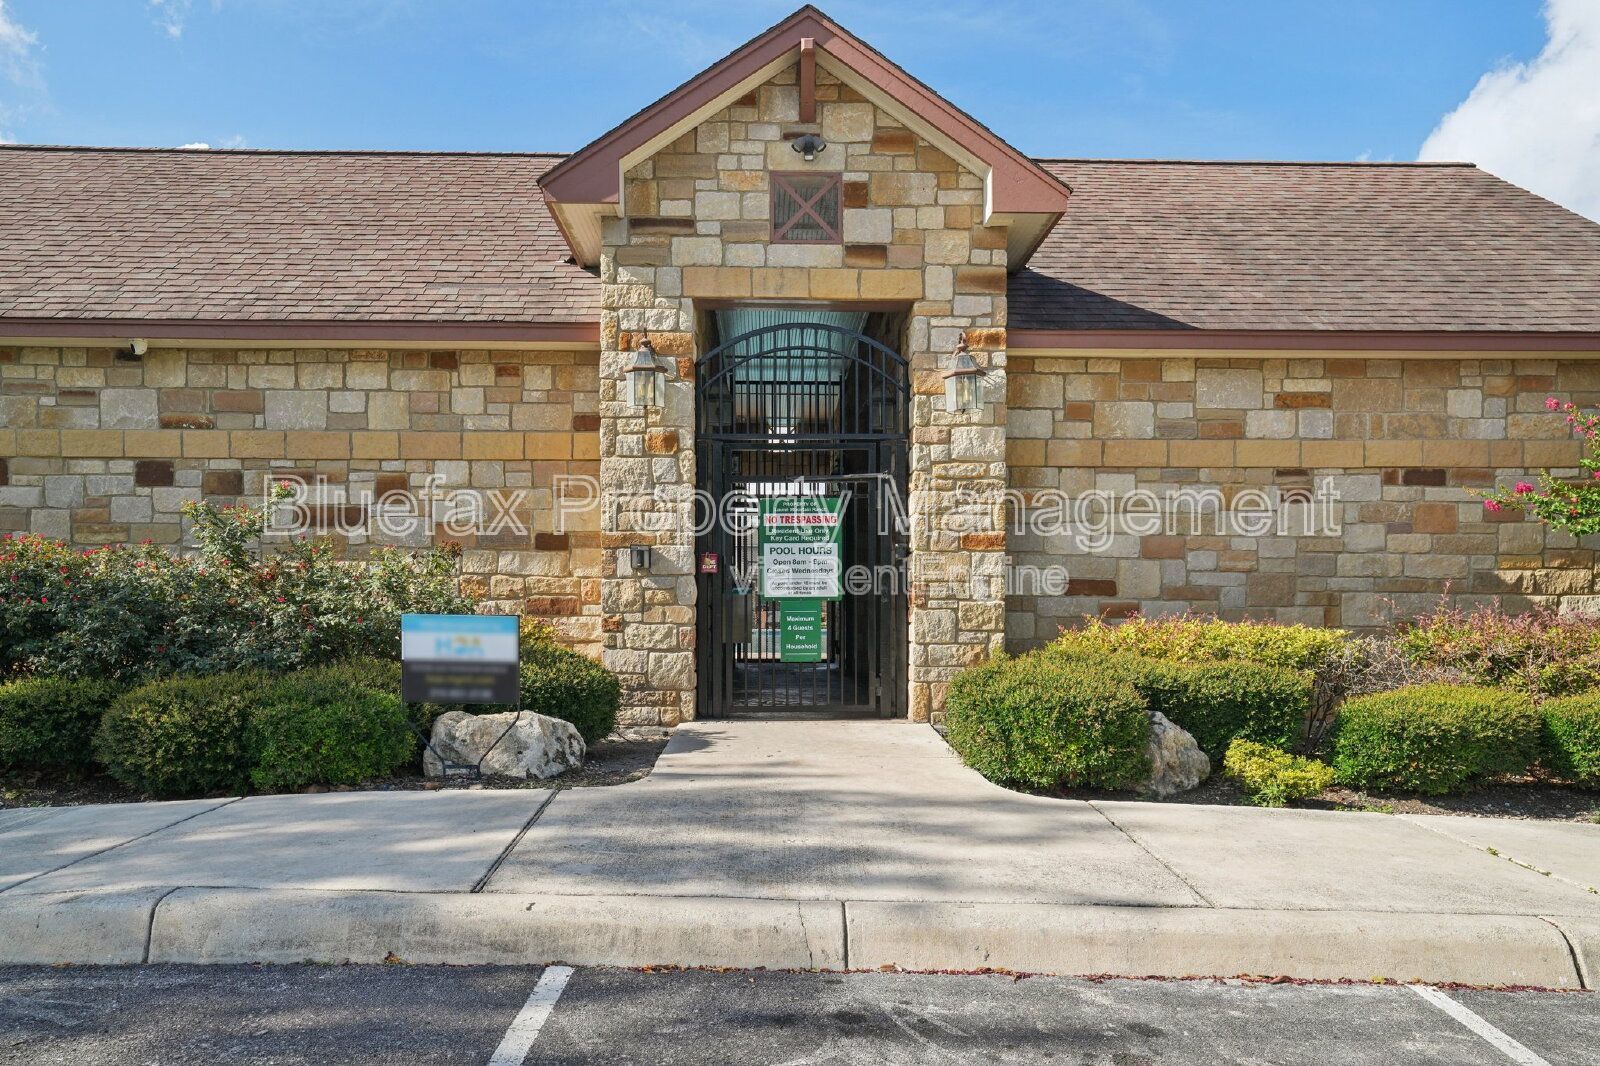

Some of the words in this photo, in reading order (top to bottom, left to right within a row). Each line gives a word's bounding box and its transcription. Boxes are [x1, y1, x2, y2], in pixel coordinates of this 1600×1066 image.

[766, 515, 778, 524] NO
[780, 515, 837, 524] TRESPASSING
[769, 547, 796, 555] POOL
[798, 547, 832, 555] HOURS
[773, 558, 791, 566] Open
